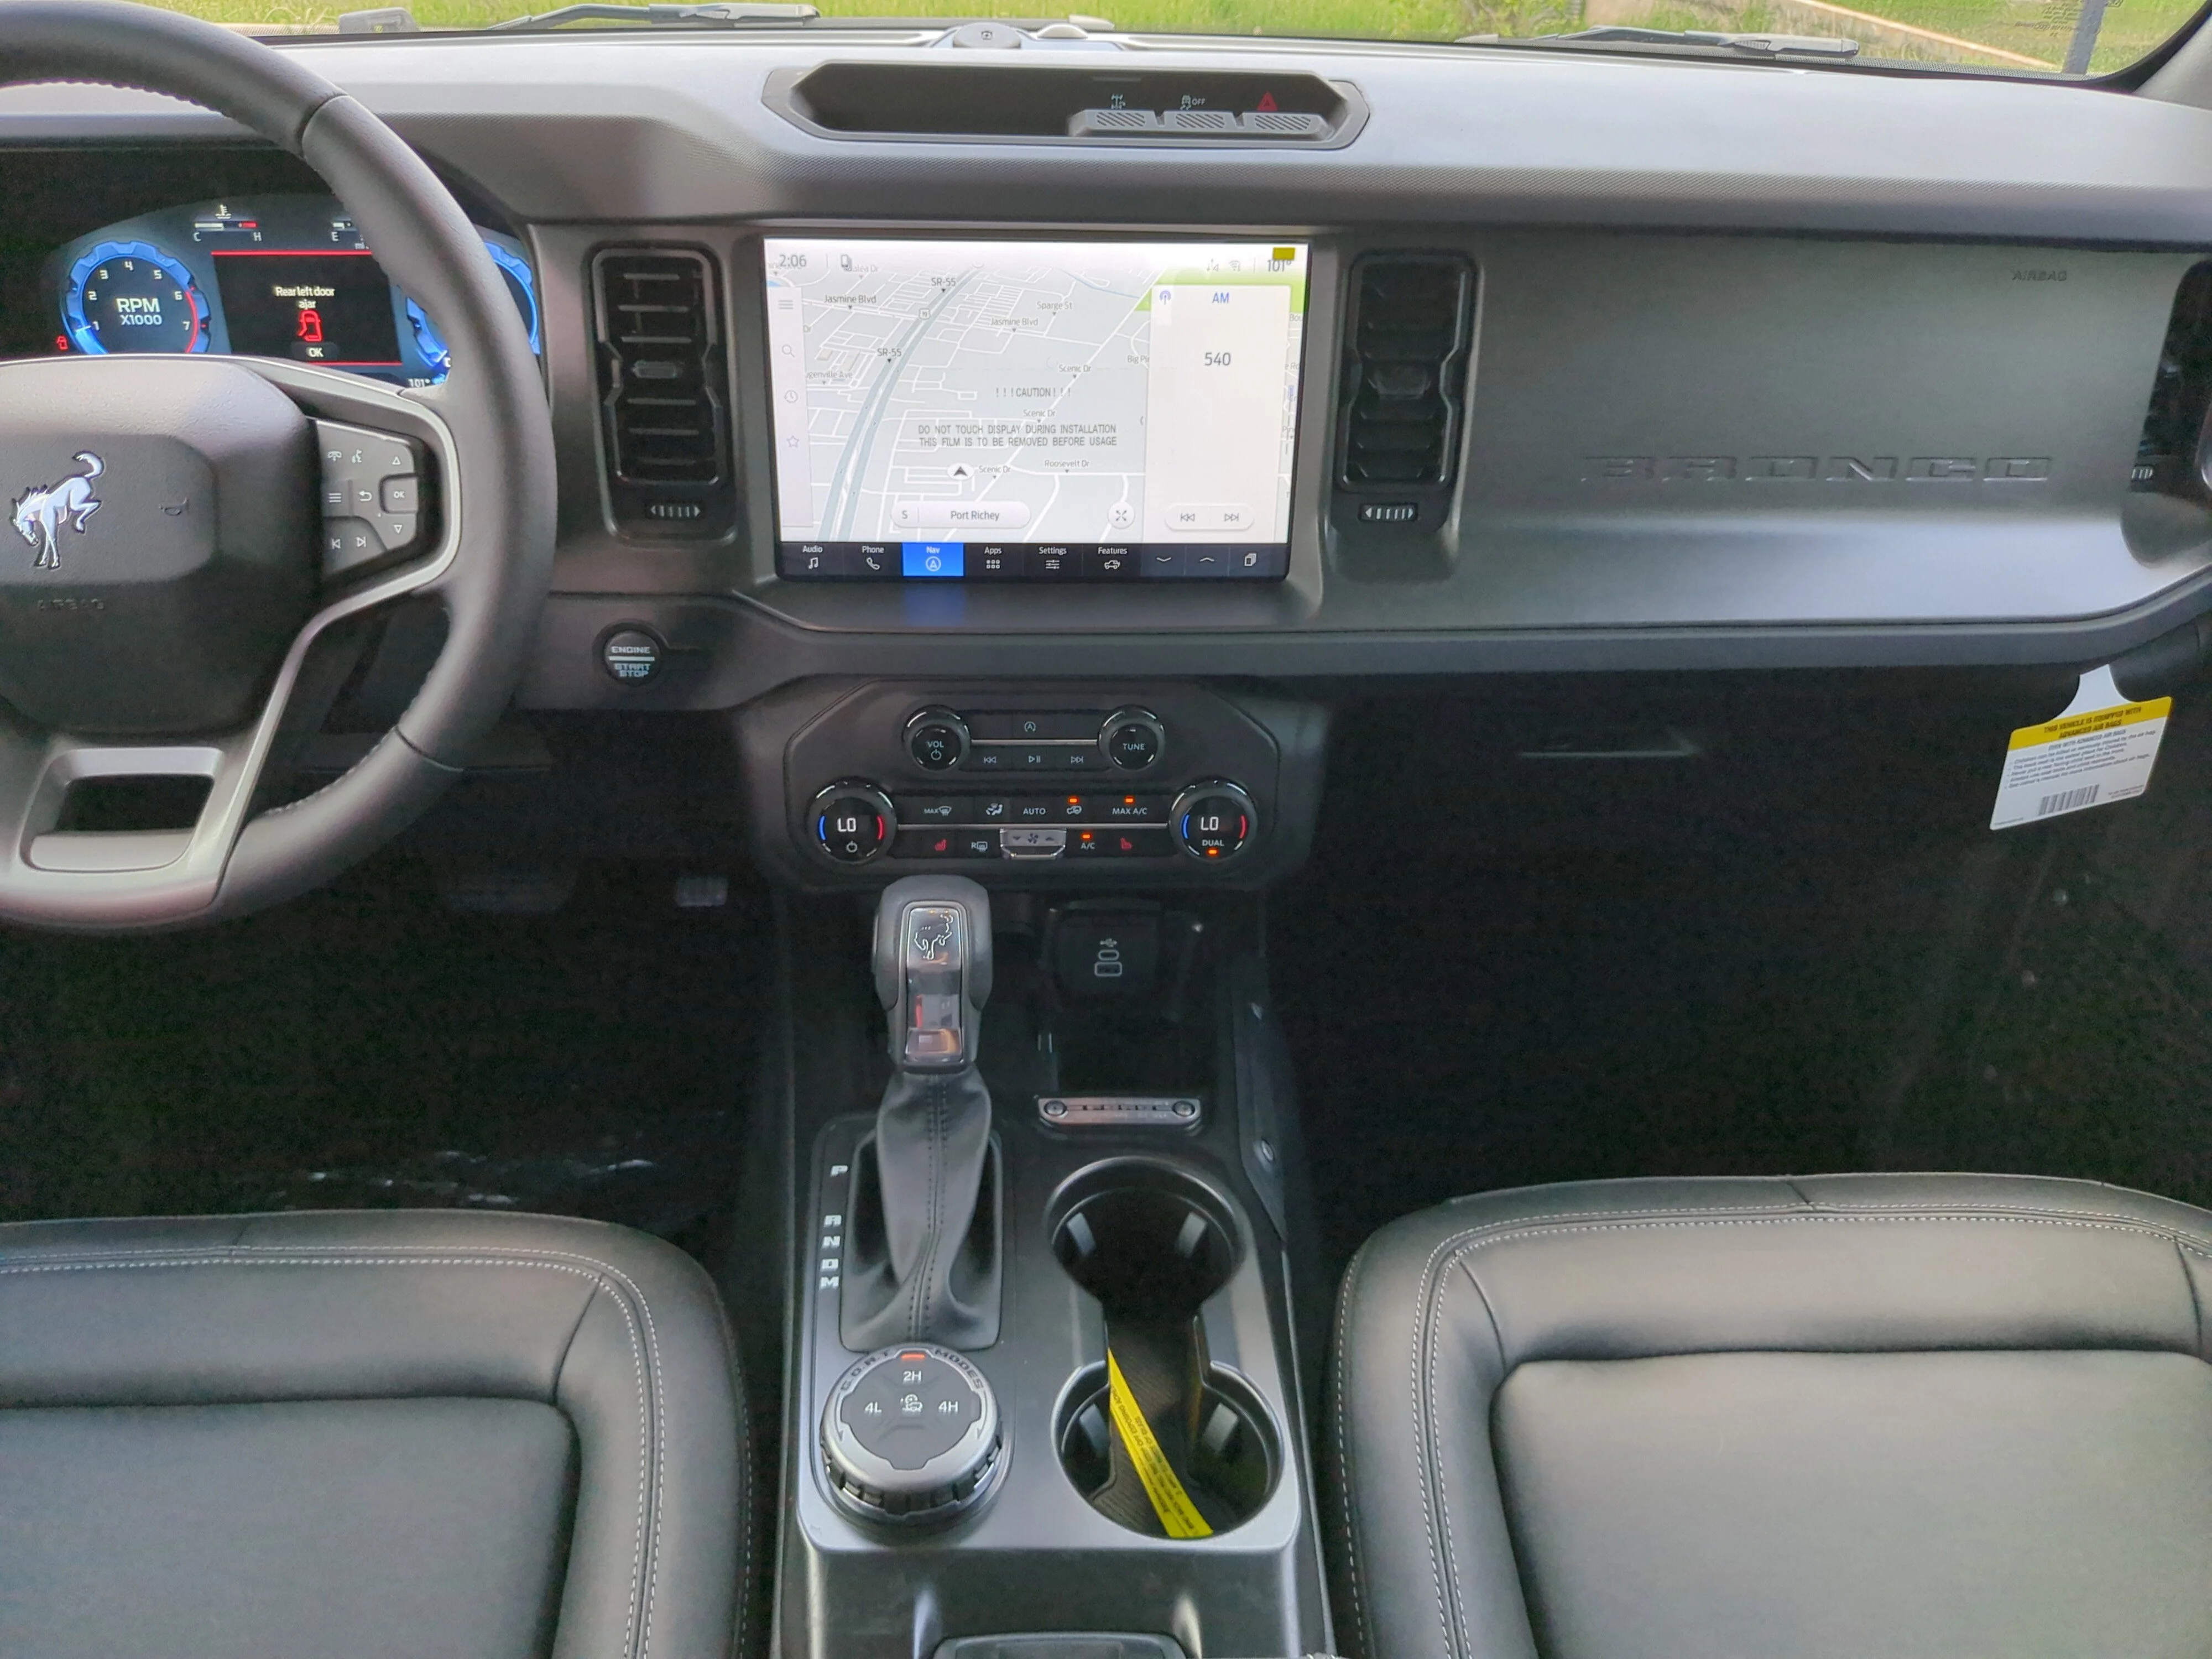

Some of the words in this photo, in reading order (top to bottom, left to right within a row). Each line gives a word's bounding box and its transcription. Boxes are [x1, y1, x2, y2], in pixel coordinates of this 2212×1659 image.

[1192, 97, 1206, 106] OFF
[193, 232, 201, 242] C
[253, 232, 262, 242] H
[331, 232, 338, 242] E
[124, 261, 133, 270] 4
[779, 254, 807, 267] 2:06
[100, 270, 108, 279] 3
[153, 269, 162, 279] 5
[931, 277, 956, 286] SR-55
[88, 291, 97, 300] 2
[174, 291, 182, 300] 6
[275, 286, 296, 296] Rear
[297, 286, 314, 296] left
[314, 286, 335, 296] door
[824, 295, 857, 304] Jasmine
[858, 295, 877, 303] Blvd
[1212, 293, 1230, 304] AM
[116, 298, 160, 312] RPM
[299, 299, 316, 310] ajar
[1037, 301, 1062, 310] Sparge
[121, 315, 162, 325] X1000
[991, 317, 1020, 326] Jasmine
[93, 321, 100, 331] 1
[182, 321, 190, 331] 7
[307, 347, 324, 357] OK
[878, 348, 901, 357] SR-55
[1128, 355, 1139, 364] Big
[1204, 353, 1230, 366] 540
[919, 425, 930, 434] DO
[935, 425, 951, 434] NOT
[956, 425, 983, 434] TOUCH
[988, 425, 1021, 434] DISPLAY
[1026, 425, 1056, 434] DURING
[1061, 424, 1116, 434] INSTALLATION
[920, 438, 937, 447] THIS
[942, 438, 960, 447] FILM
[965, 438, 972, 447] IS
[977, 437, 988, 446] TO
[993, 437, 1004, 446] BE
[1008, 437, 1048, 446] REMOVED
[1053, 437, 1085, 446] BEFORE
[1089, 437, 1117, 446] USAGE
[1582, 455, 2052, 482] BRONCO
[951, 511, 968, 520] Port
[971, 511, 999, 521] Richey
[984, 547, 1002, 555] Apps
[1039, 547, 1067, 556] Settings
[837, 818, 857, 832] LO
[1201, 817, 1219, 831] LO
[830, 1165, 848, 1177] P
[822, 1235, 841, 1249] N
[821, 1258, 839, 1272] D
[820, 1276, 839, 1290] M
[935, 1348, 984, 1389] MODES
[902, 1371, 922, 1382] 2H
[864, 1405, 882, 1414] 4L
[938, 1401, 959, 1412] 4H
